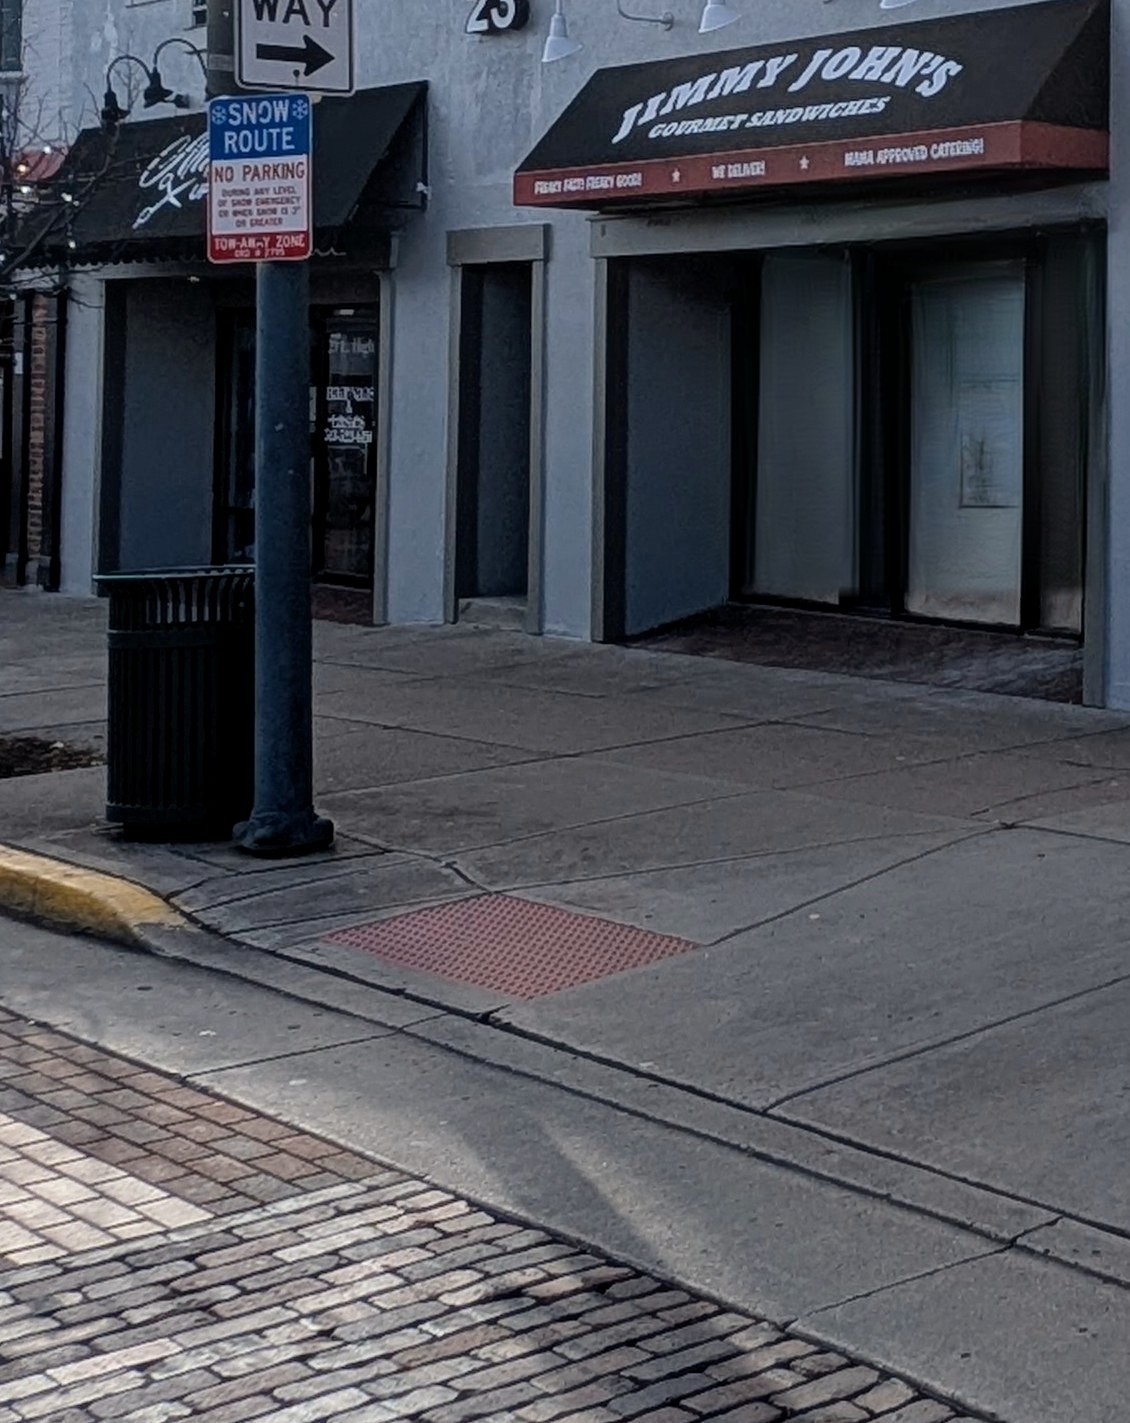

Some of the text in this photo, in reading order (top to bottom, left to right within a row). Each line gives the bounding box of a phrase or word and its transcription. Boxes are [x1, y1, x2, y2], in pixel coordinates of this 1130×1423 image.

[611, 46, 963, 144] JIMMY JOHN'S
[228, 99, 290, 126] SNOW
[648, 96, 891, 139] GOURMET SANDWICHES
[224, 127, 296, 154] ROUTE
[214, 161, 305, 183] NO PARKING
[275, 234, 305, 250] ZONE
